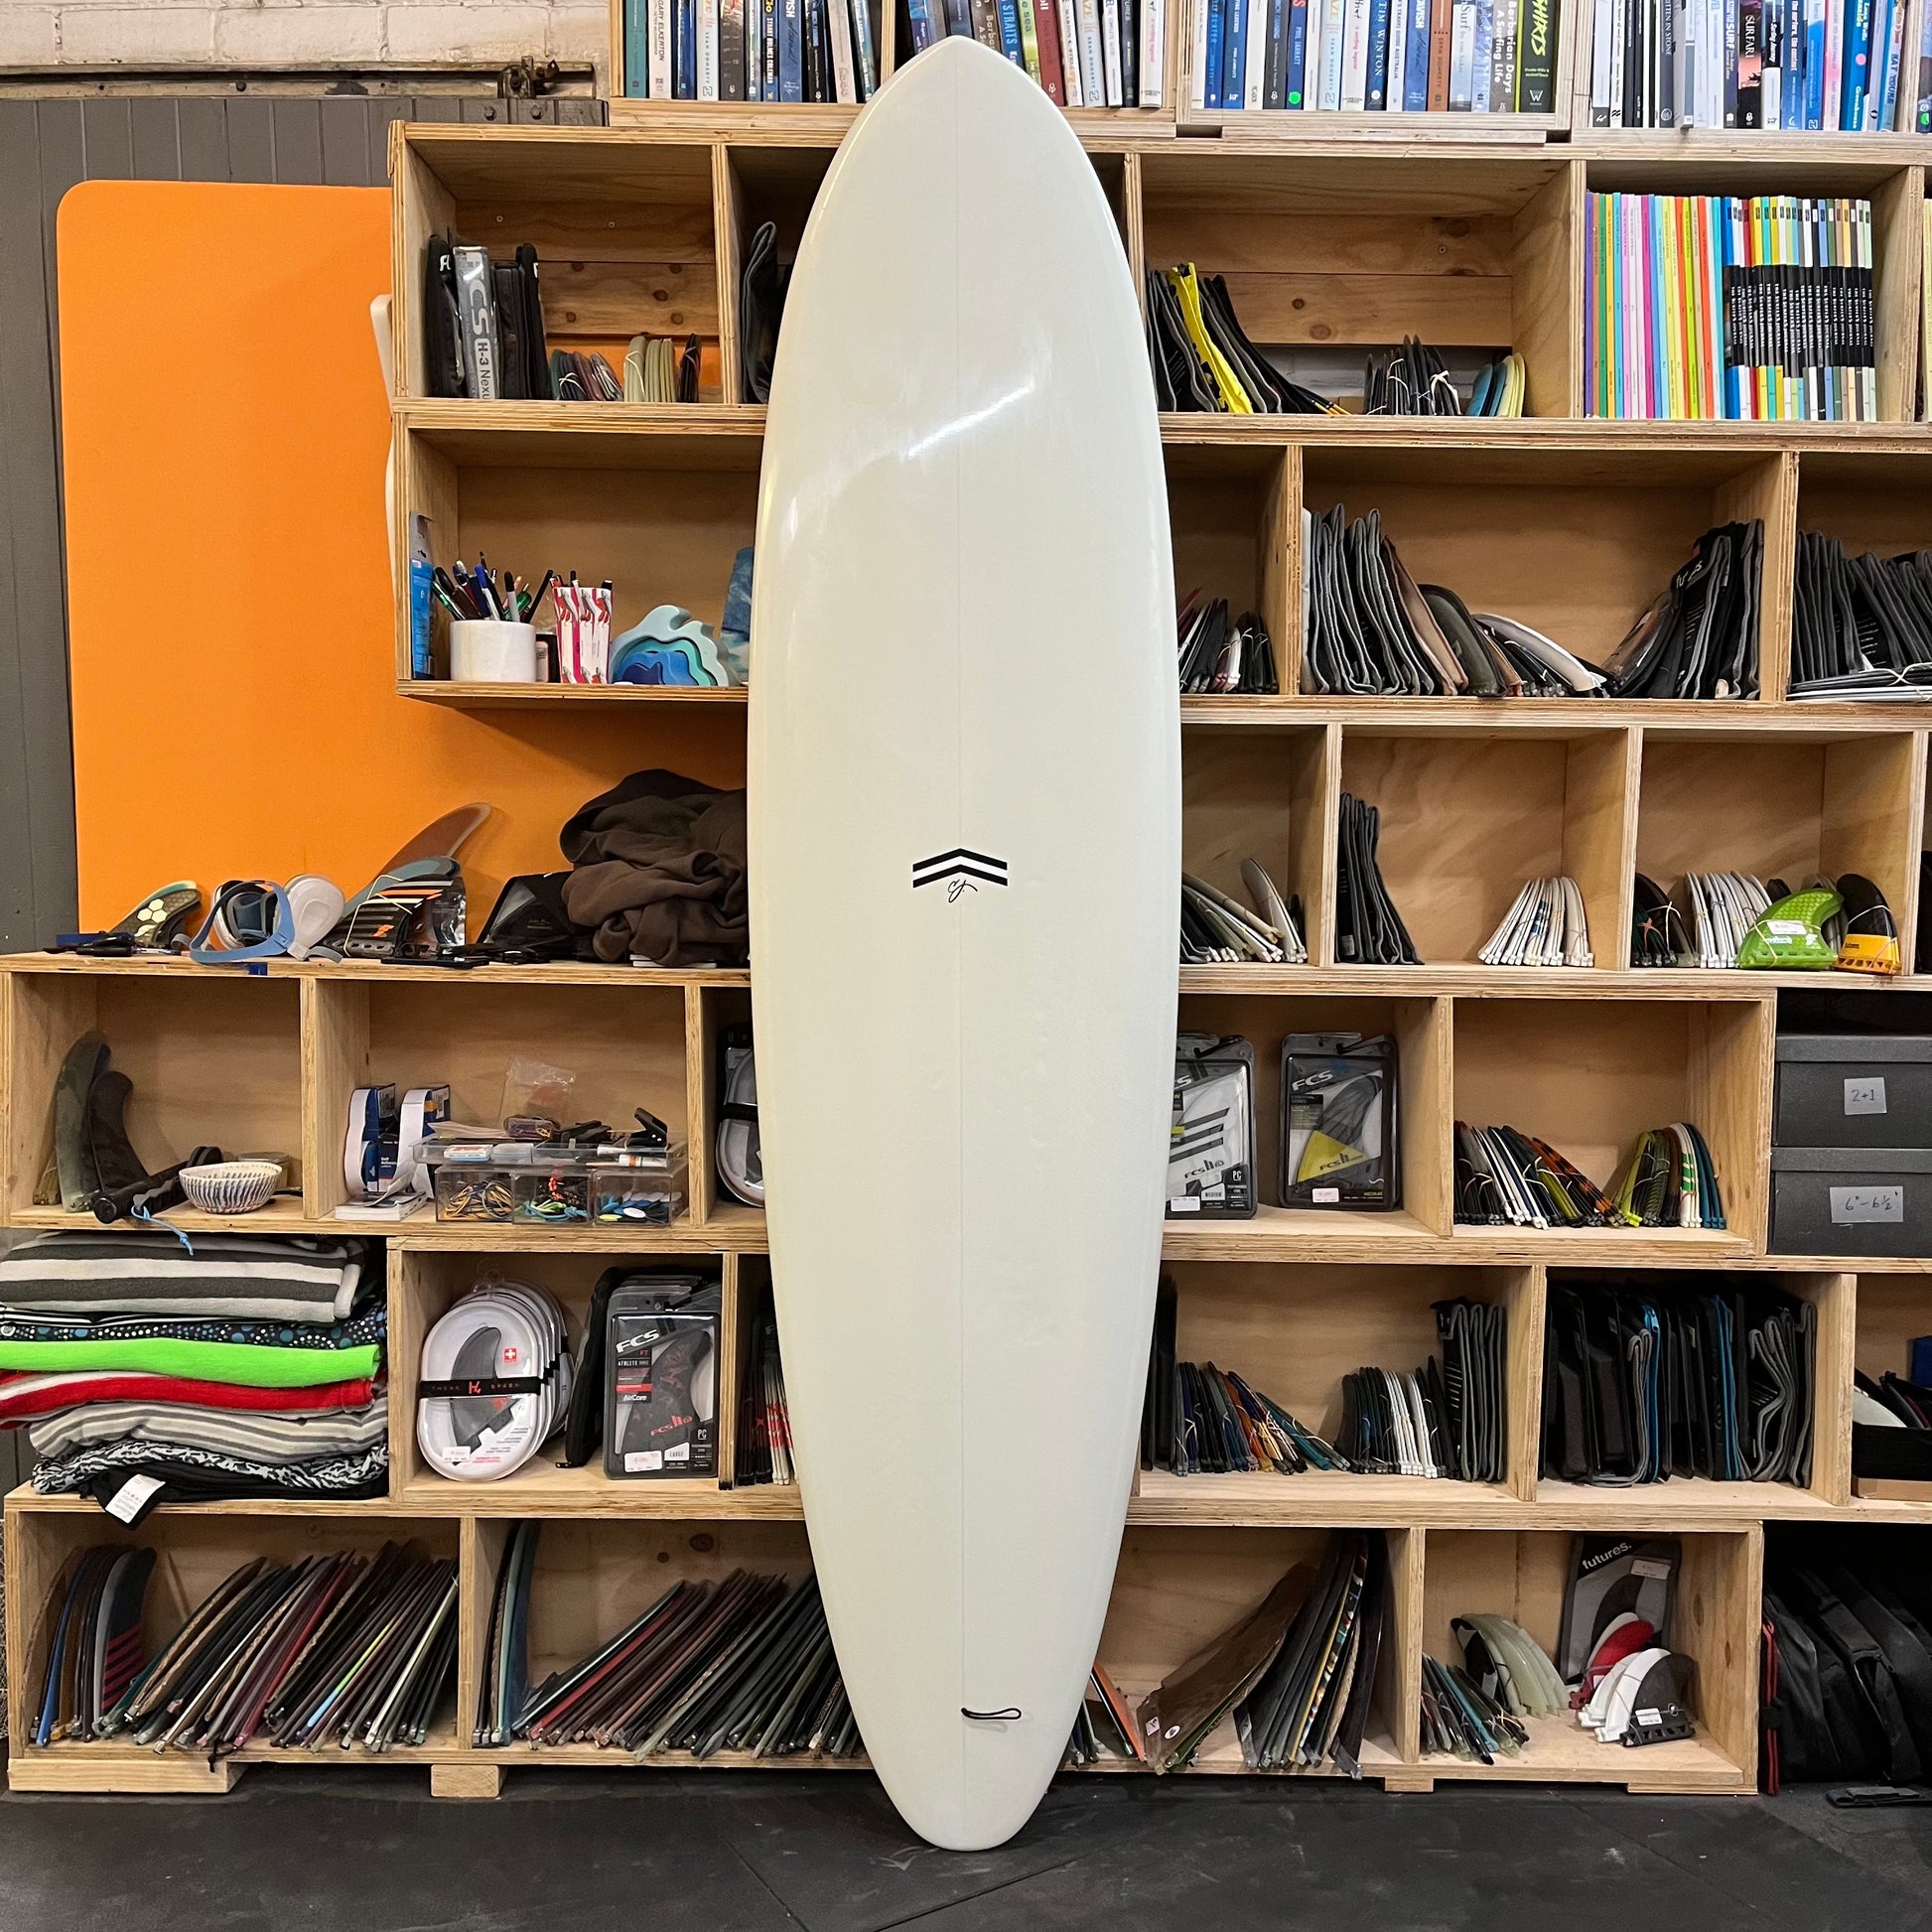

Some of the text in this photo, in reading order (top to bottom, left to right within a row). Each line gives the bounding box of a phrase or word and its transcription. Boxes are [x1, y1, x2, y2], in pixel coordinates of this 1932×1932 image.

[1001, 4, 1018, 45] STRAITS
[1022, 12, 1034, 33] sea
[1293, 26, 1303, 66] PHIL JARRATT
[1373, 1, 1388, 76] TIM WINTON
[1493, 20, 1505, 60] Surfing
[1502, 1, 1517, 94] Barbarian Days
[1665, 33, 1674, 57] STONE
[1725, 23, 1735, 50] SURF
[1744, 15, 1755, 59] SURFARI
[1493, 64, 1503, 83] Life
[1890, 53, 1899, 71] NAT
[1852, 85, 1863, 129] Greenhouse
[477, 342, 489, 366] H-3
[480, 369, 493, 400] Nexu
[1291, 1069, 1334, 1092] FCS
[1851, 1088, 1875, 1103] 2+1
[1232, 1170, 1242, 1181] PC
[616, 1328, 661, 1354] FCS
[623, 1393, 648, 1403] AirCore
[697, 1428, 708, 1441] PC
[1582, 1542, 1633, 1570] futures.
